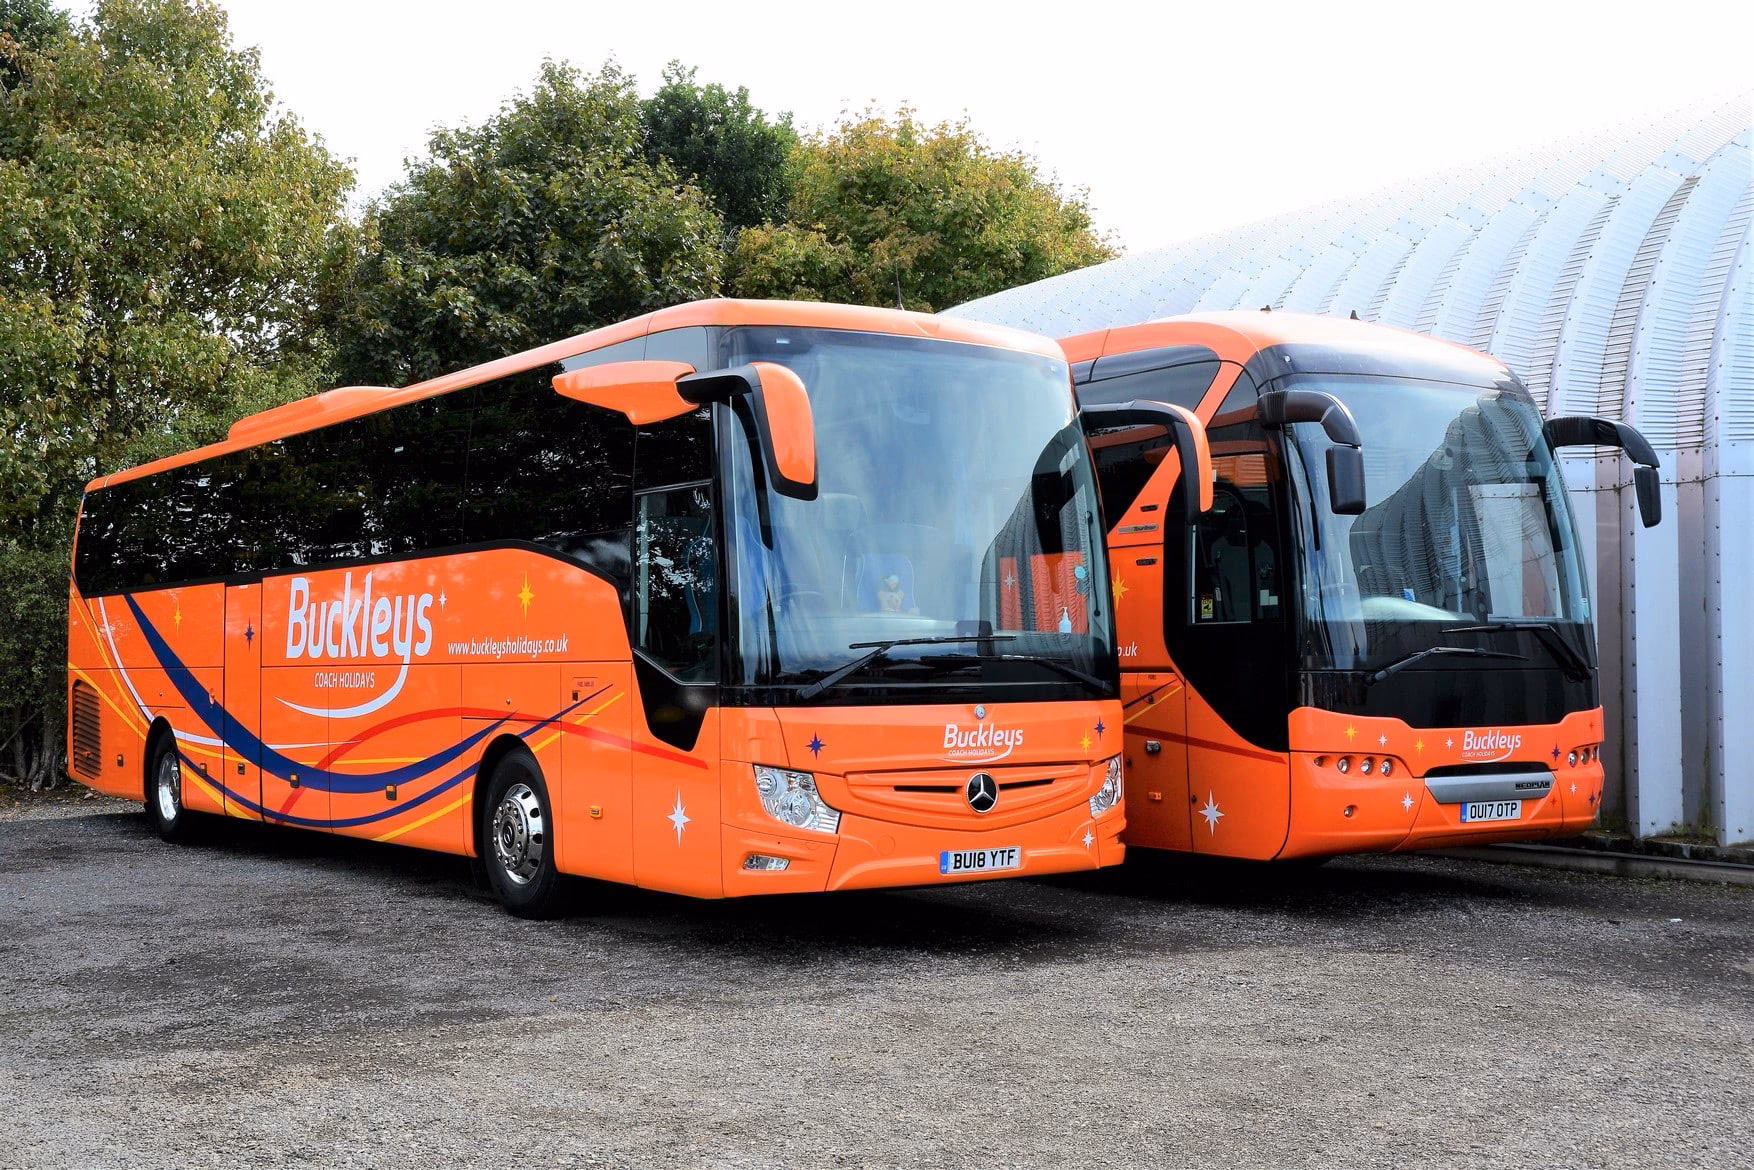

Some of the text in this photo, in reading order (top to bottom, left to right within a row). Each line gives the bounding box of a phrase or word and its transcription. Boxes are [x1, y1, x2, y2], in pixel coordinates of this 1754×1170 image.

[285, 569, 434, 664] Buckleys
[448, 633, 569, 660] www.buckleysholidays.co.uk
[314, 671, 375, 689] COACH HOLIDAYS
[944, 724, 1023, 749] Buckleys
[1463, 730, 1521, 751] Buckleys
[968, 749, 994, 757] HOLIDAYS
[1515, 781, 1550, 790] NEOPLAN
[1470, 802, 1518, 819] OU17 OTP
[952, 849, 1016, 870] BU18 YTF
